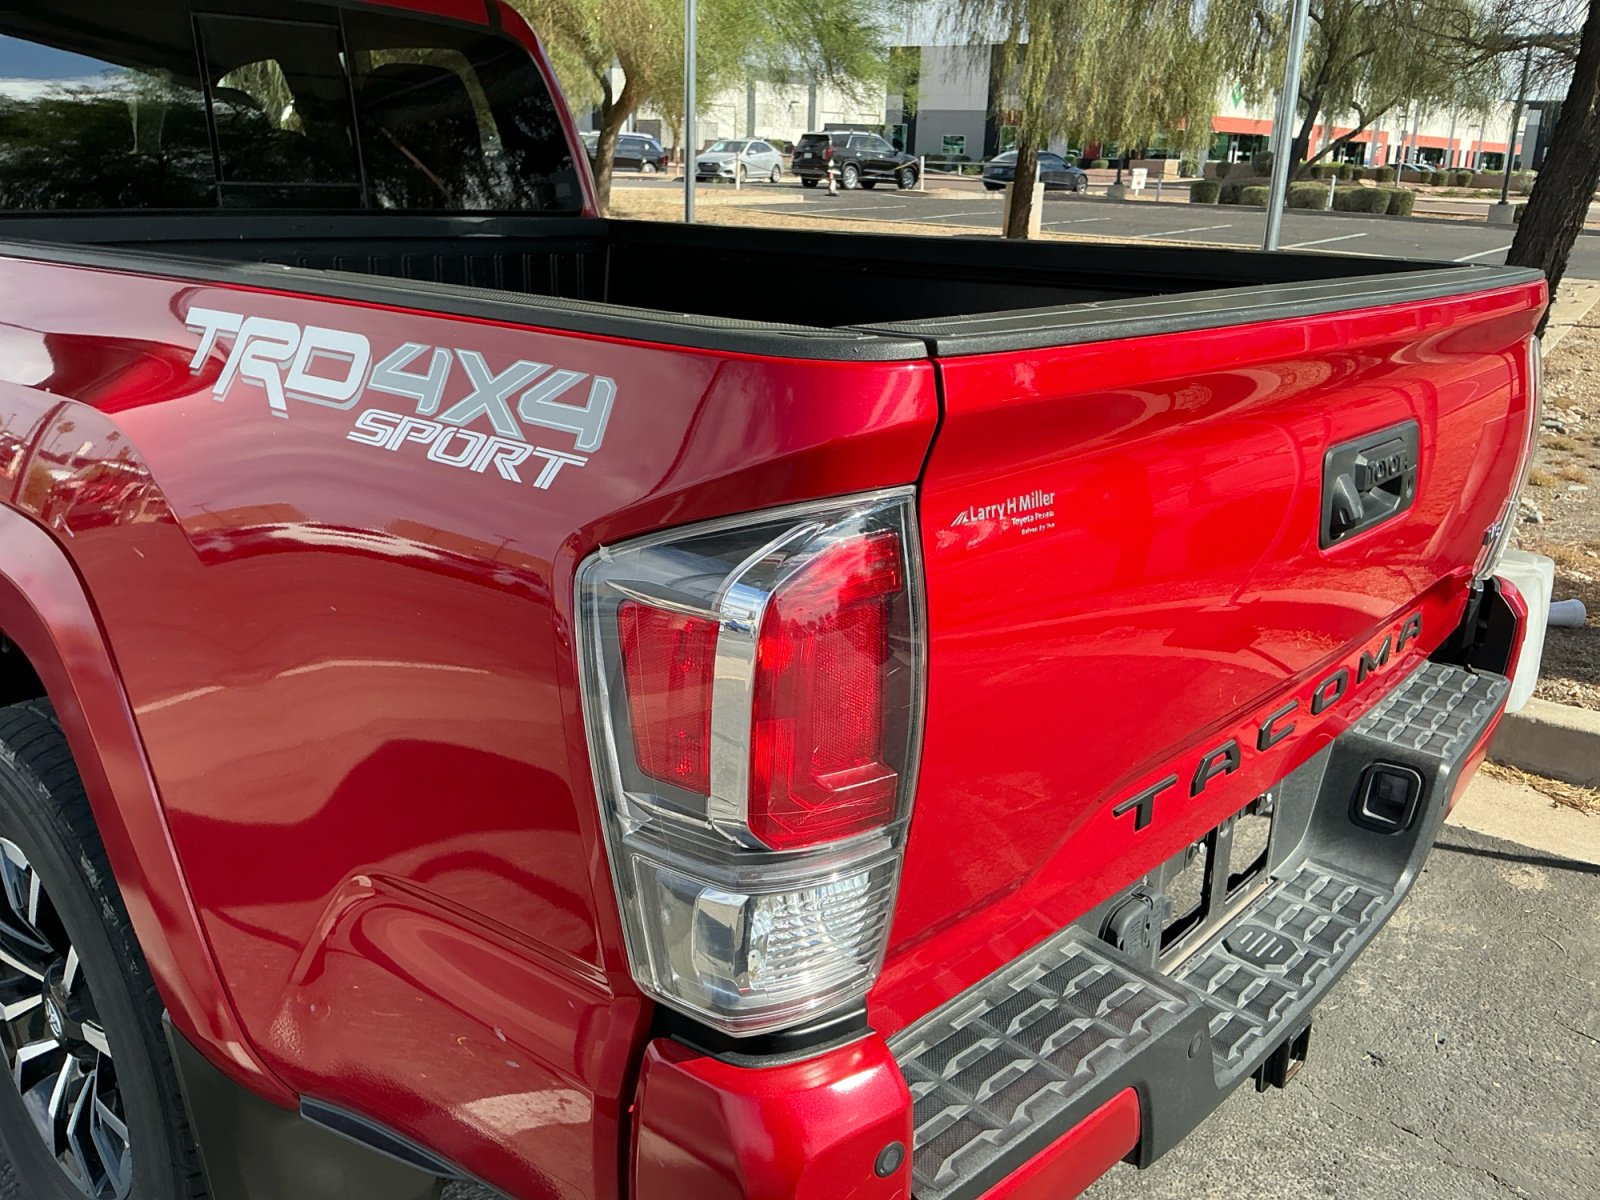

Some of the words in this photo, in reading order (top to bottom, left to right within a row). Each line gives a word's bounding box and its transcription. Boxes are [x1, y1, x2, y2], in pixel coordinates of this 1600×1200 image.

[185, 307, 373, 419] TRD
[346, 408, 588, 490] SPORT
[970, 503, 1005, 521] Larry
[1007, 497, 1017, 515] H
[1019, 490, 1055, 512] Miller
[1011, 514, 1034, 527] Toyota
[1113, 611, 1423, 832] TACOMA
